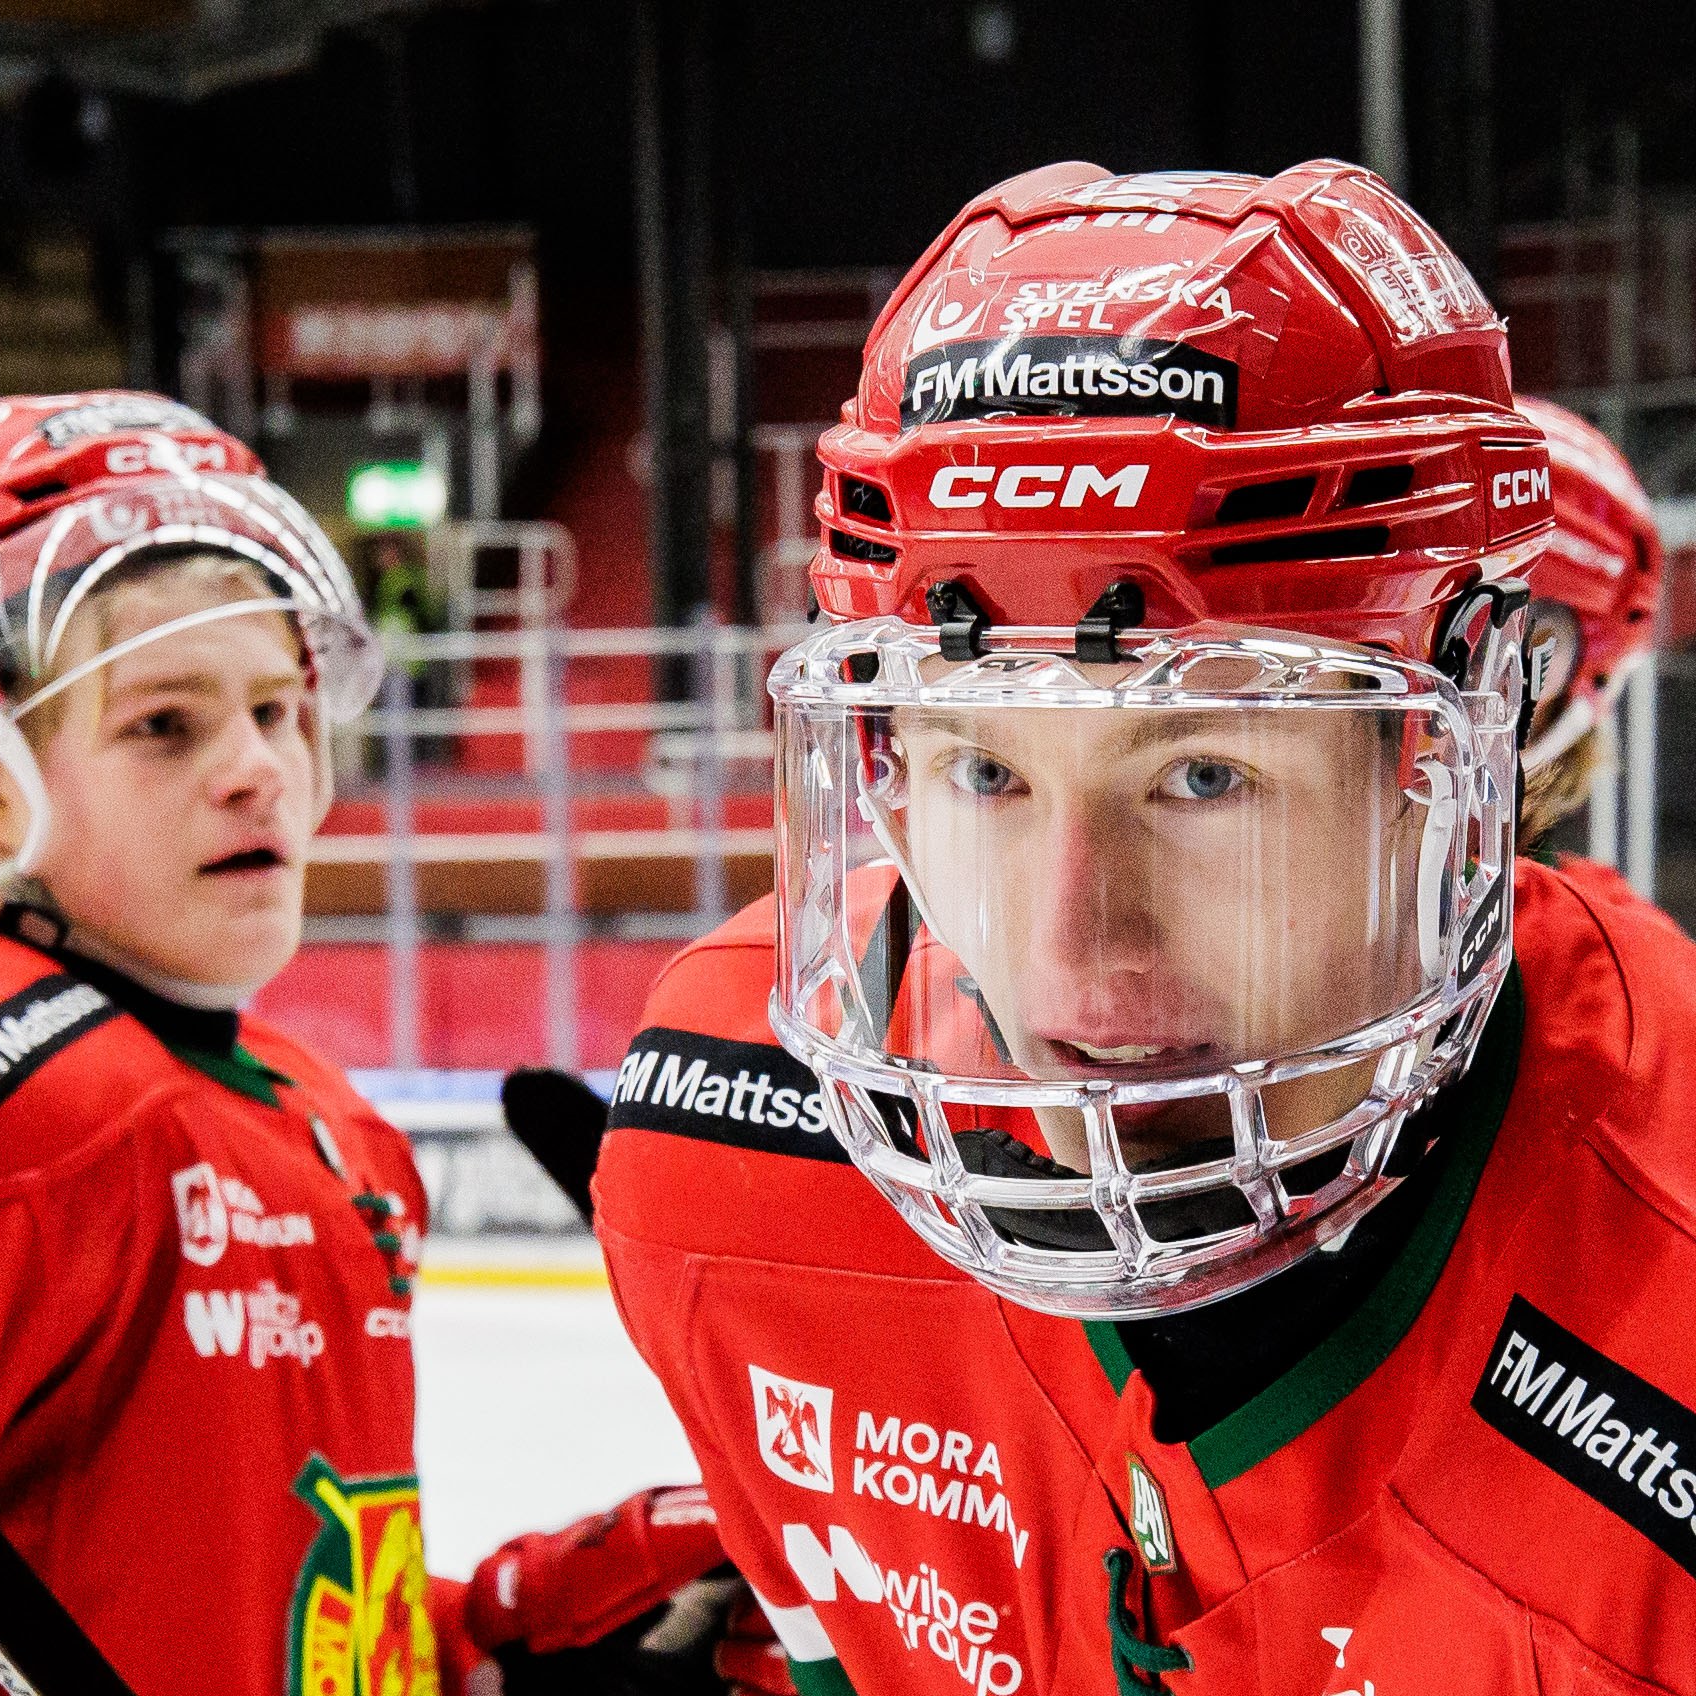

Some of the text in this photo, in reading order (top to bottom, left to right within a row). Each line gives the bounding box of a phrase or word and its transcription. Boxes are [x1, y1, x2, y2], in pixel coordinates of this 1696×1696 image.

[1000, 302, 1114, 331] SPEL
[1012, 279, 1233, 319] SVENSKA
[912, 355, 1224, 411] FM Mattsson
[929, 465, 1149, 508] CCM
[1493, 467, 1551, 509] CCM
[654, 1057, 831, 1134] Mattss
[1490, 1329, 1561, 1417] FM
[855, 1411, 1004, 1486] MORA
[875, 1563, 999, 1645] wibe
